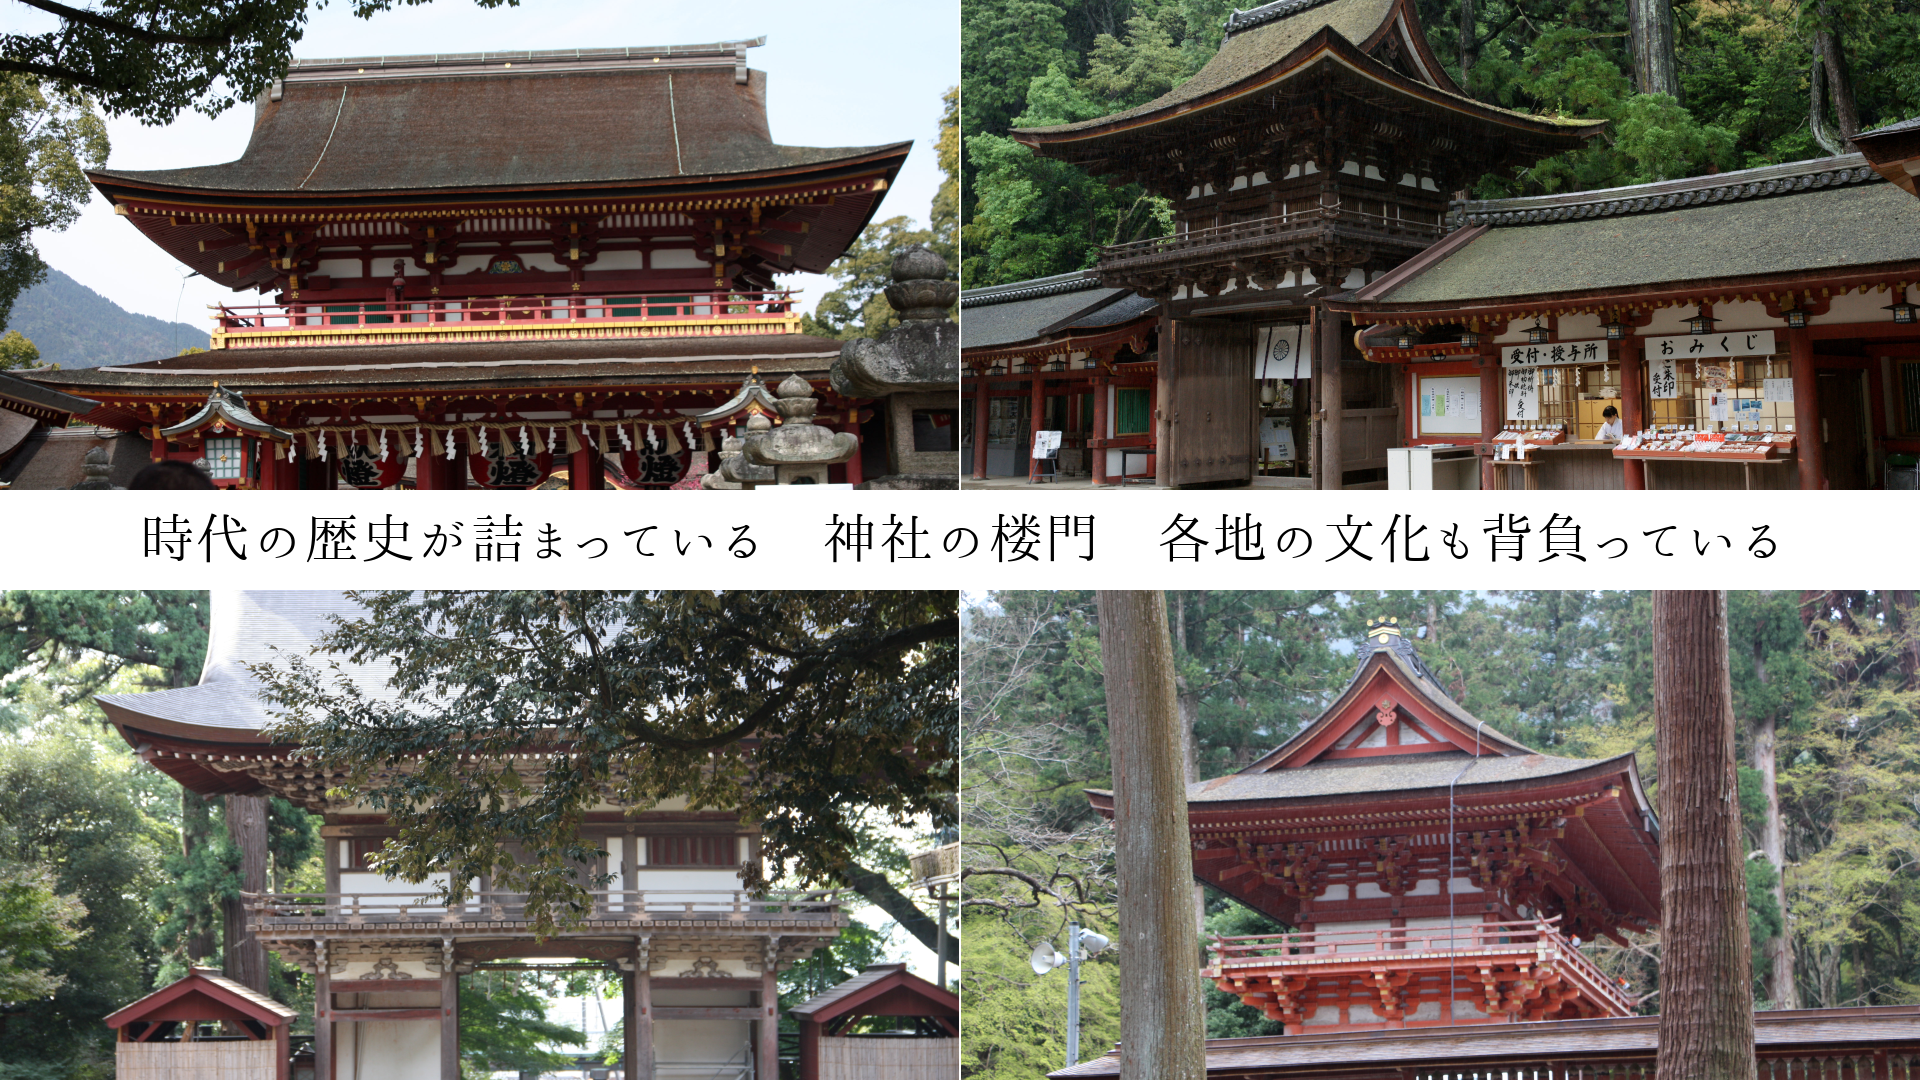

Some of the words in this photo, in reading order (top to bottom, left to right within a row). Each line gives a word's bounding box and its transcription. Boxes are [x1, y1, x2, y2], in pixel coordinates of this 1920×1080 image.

[1511, 343, 1598, 364] 受付・授与所
[1660, 334, 1758, 355] おみくじ
[1652, 372, 1662, 397] 受付
[1663, 359, 1675, 397] ご朱印
[1516, 398, 1525, 418] 受付
